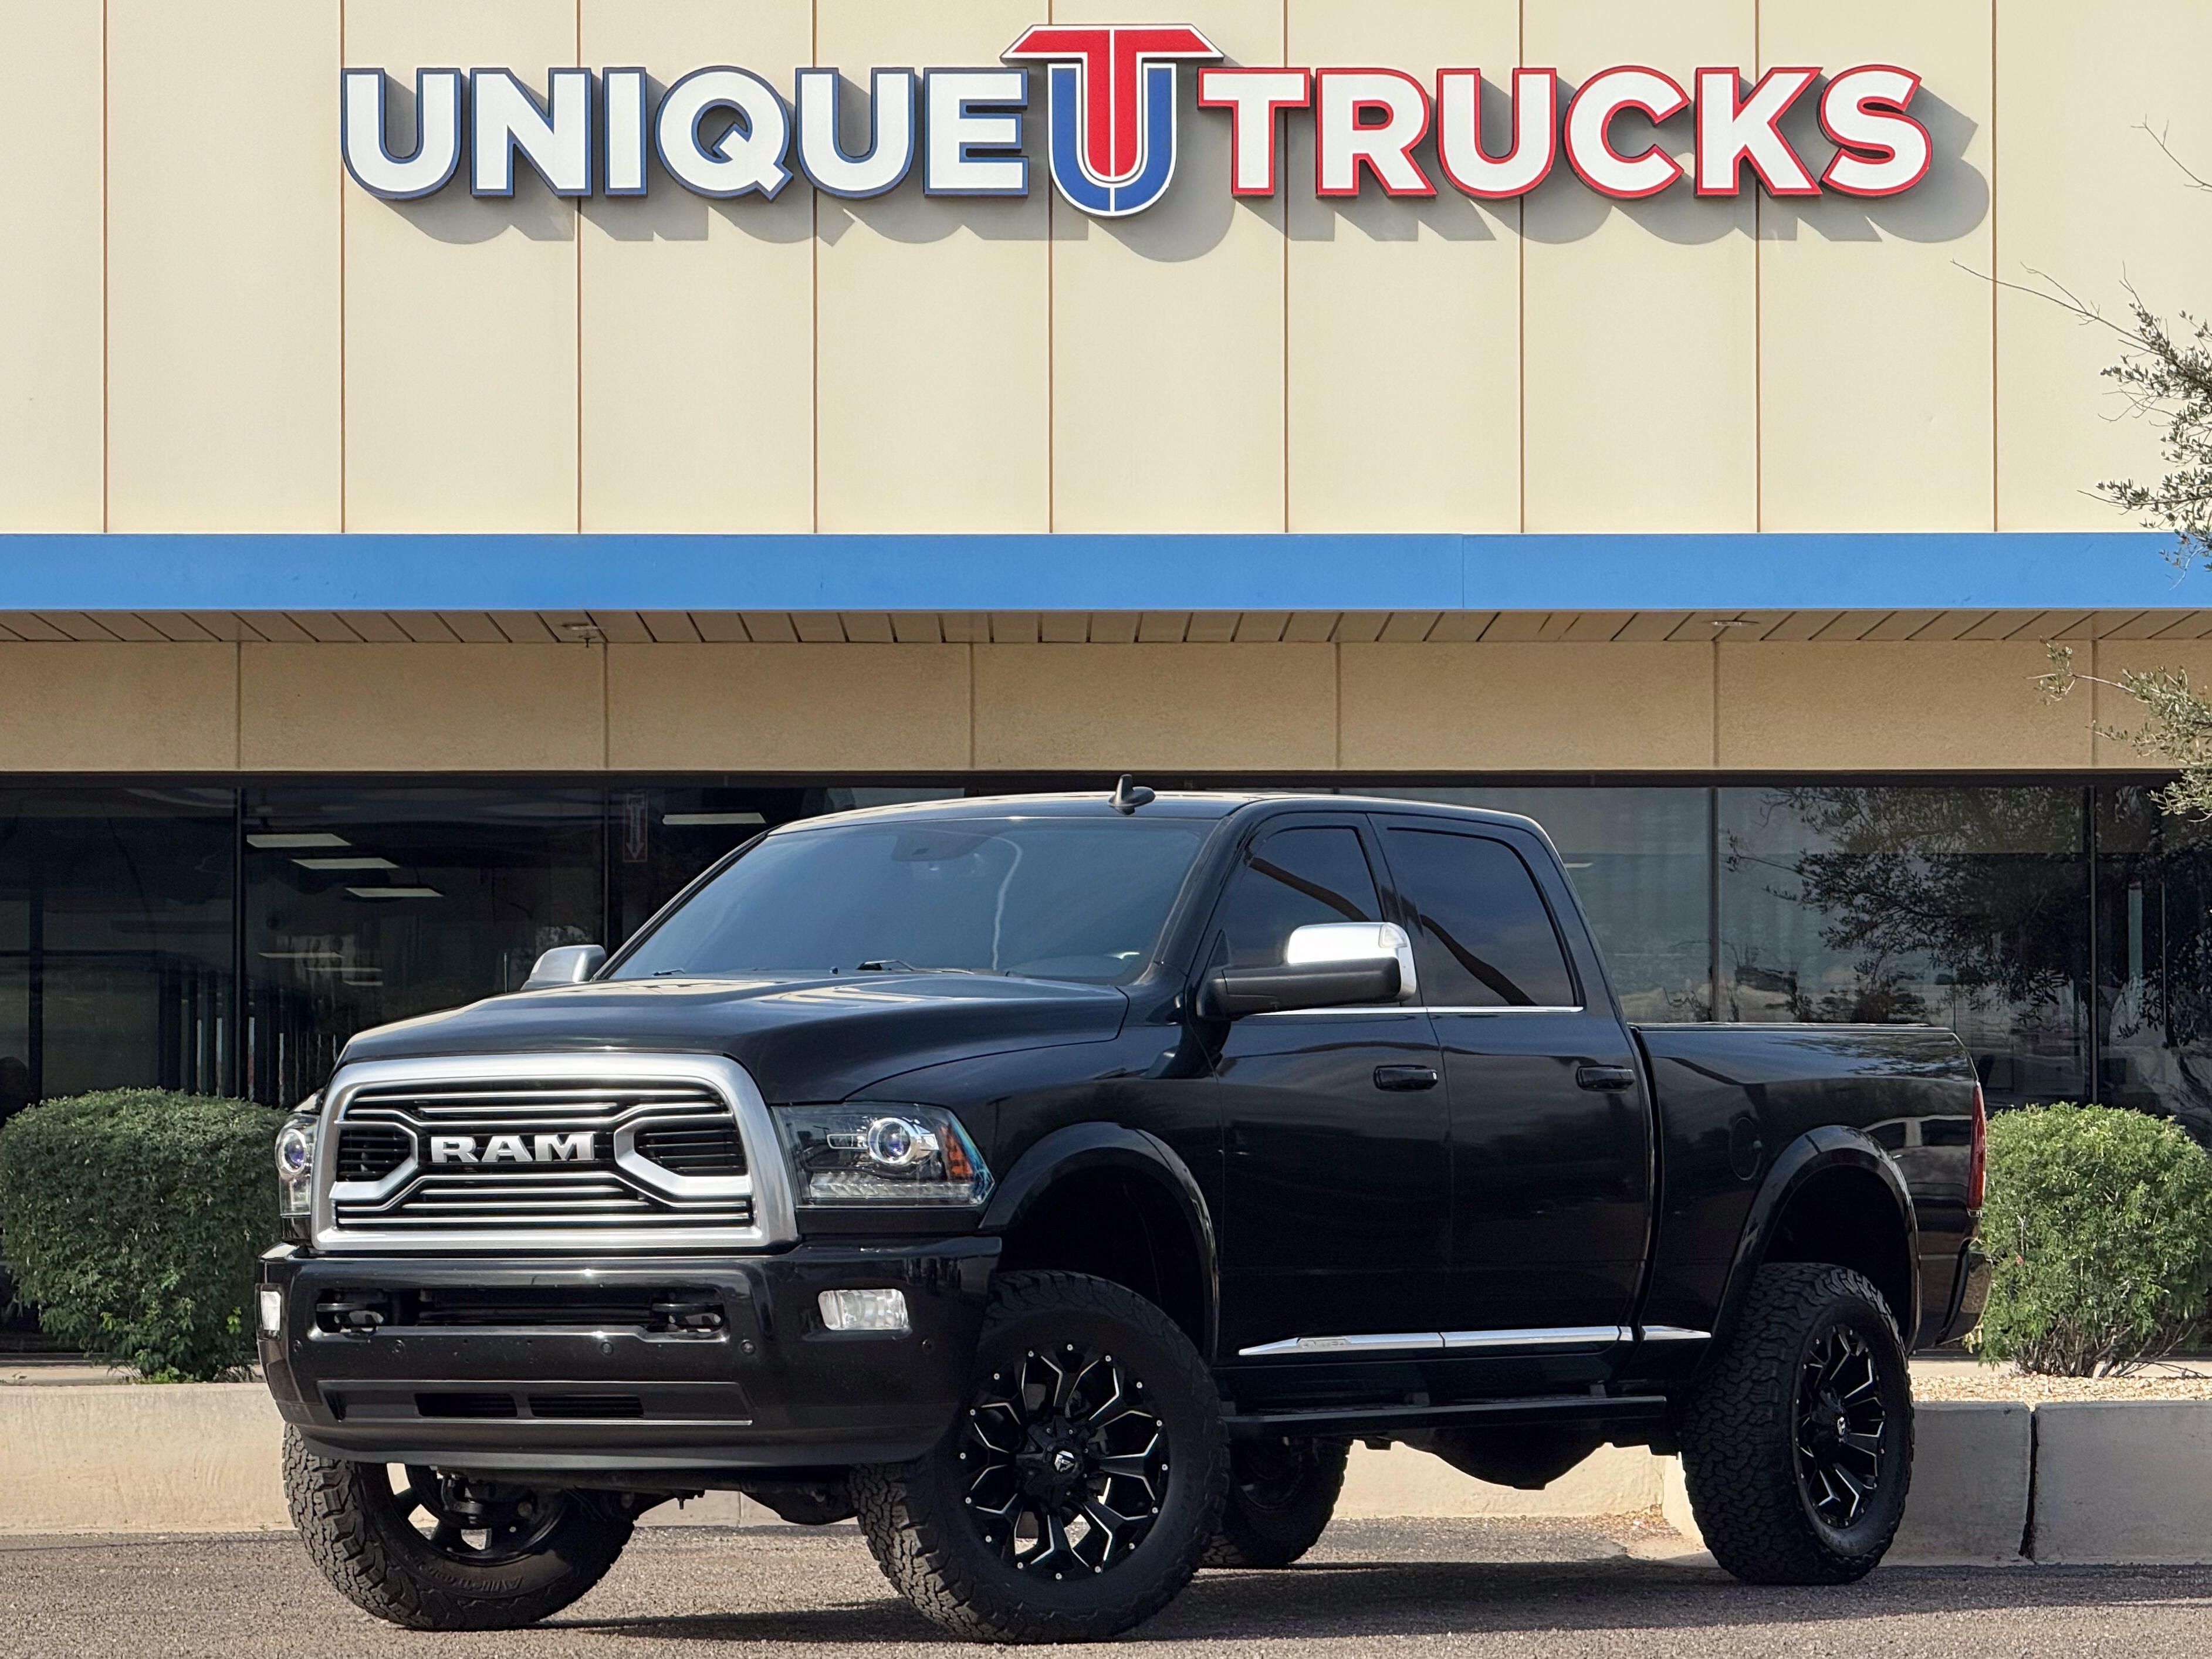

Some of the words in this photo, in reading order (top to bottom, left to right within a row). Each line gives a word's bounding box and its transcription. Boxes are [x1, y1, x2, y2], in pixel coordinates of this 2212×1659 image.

[341, 66, 1029, 202] UNIQUE
[1197, 65, 1933, 199] TRUCKS
[431, 1132, 595, 1163] RAM
